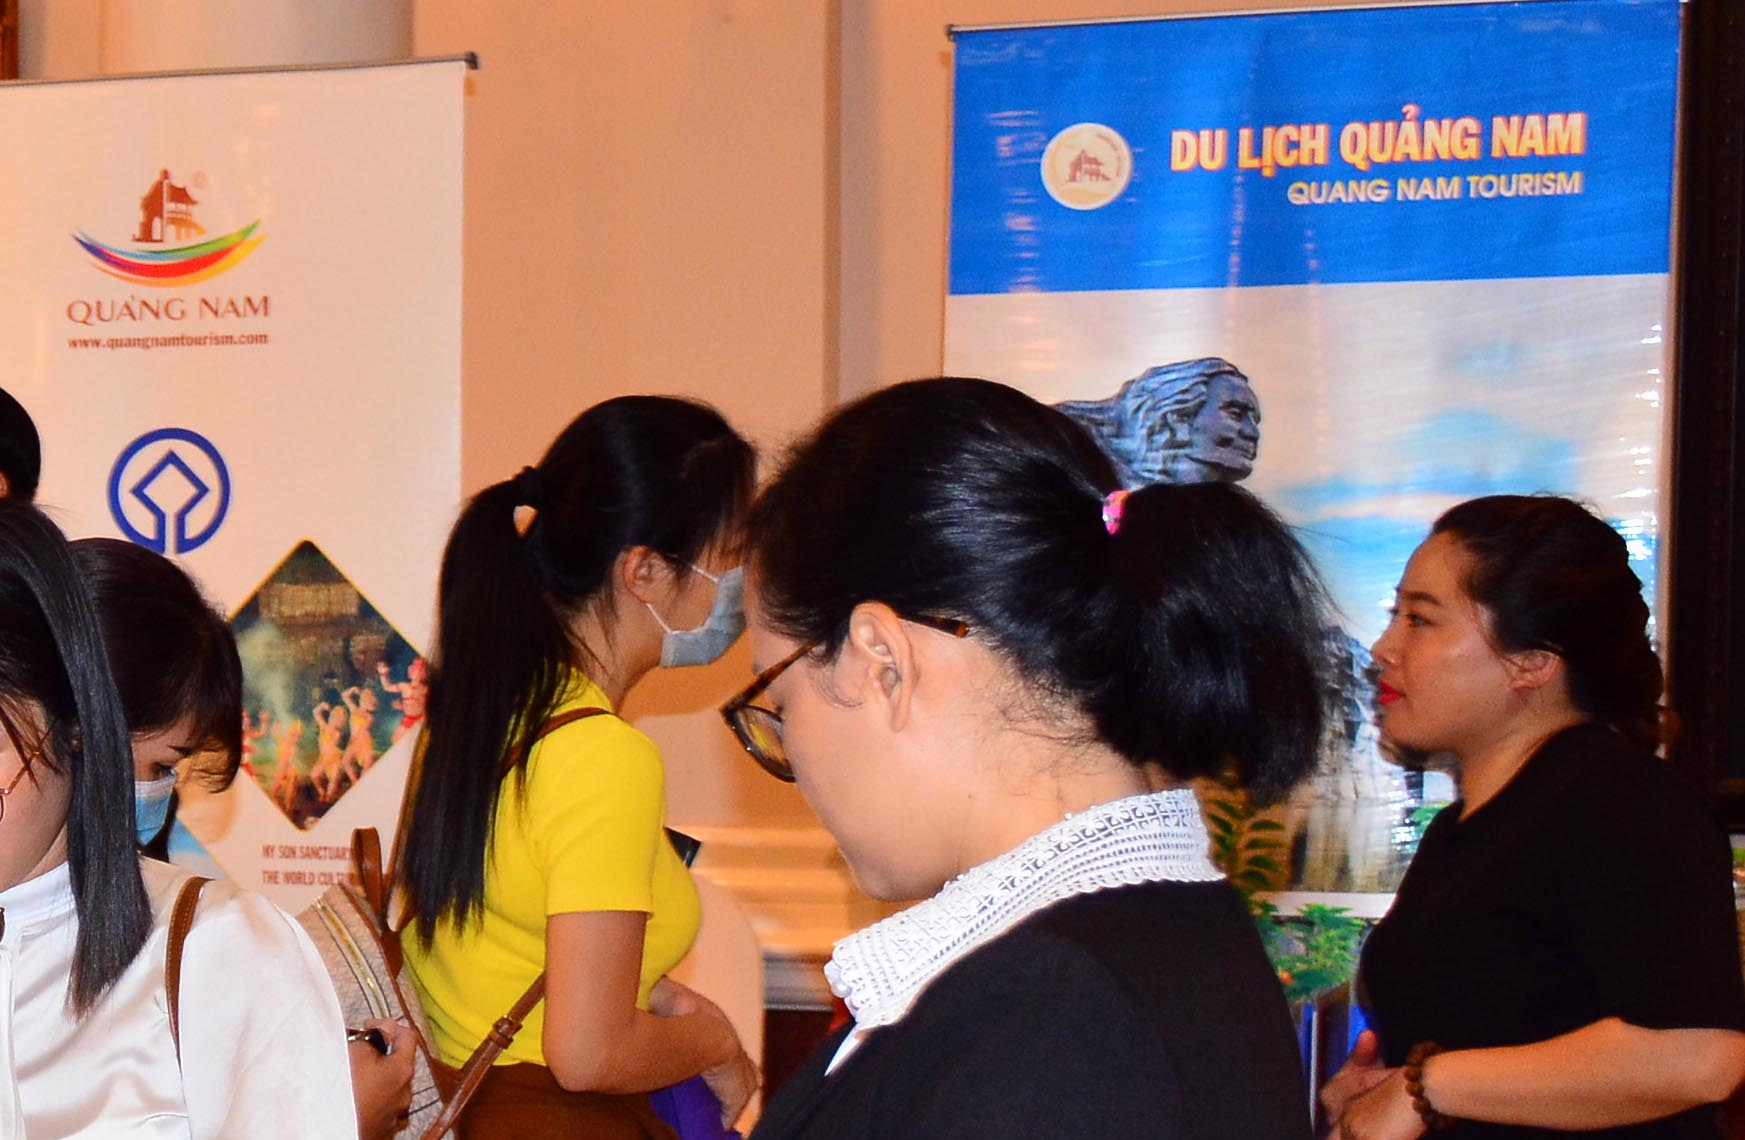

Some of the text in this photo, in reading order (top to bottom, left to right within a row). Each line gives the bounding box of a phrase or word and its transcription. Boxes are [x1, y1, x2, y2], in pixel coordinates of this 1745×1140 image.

[1170, 128, 1228, 172] DU
[1237, 123, 1330, 178] LỊCH
[1338, 103, 1481, 172] QUẢNG
[1490, 111, 1587, 158] NAM
[1286, 170, 1584, 205] QUANG NAM TOURISM
[66, 295, 271, 327] QUẢNG NAM
[67, 331, 269, 350] www.quangnamtourism.com
[262, 871, 279, 885] THE
[282, 871, 315, 886] WORLD
